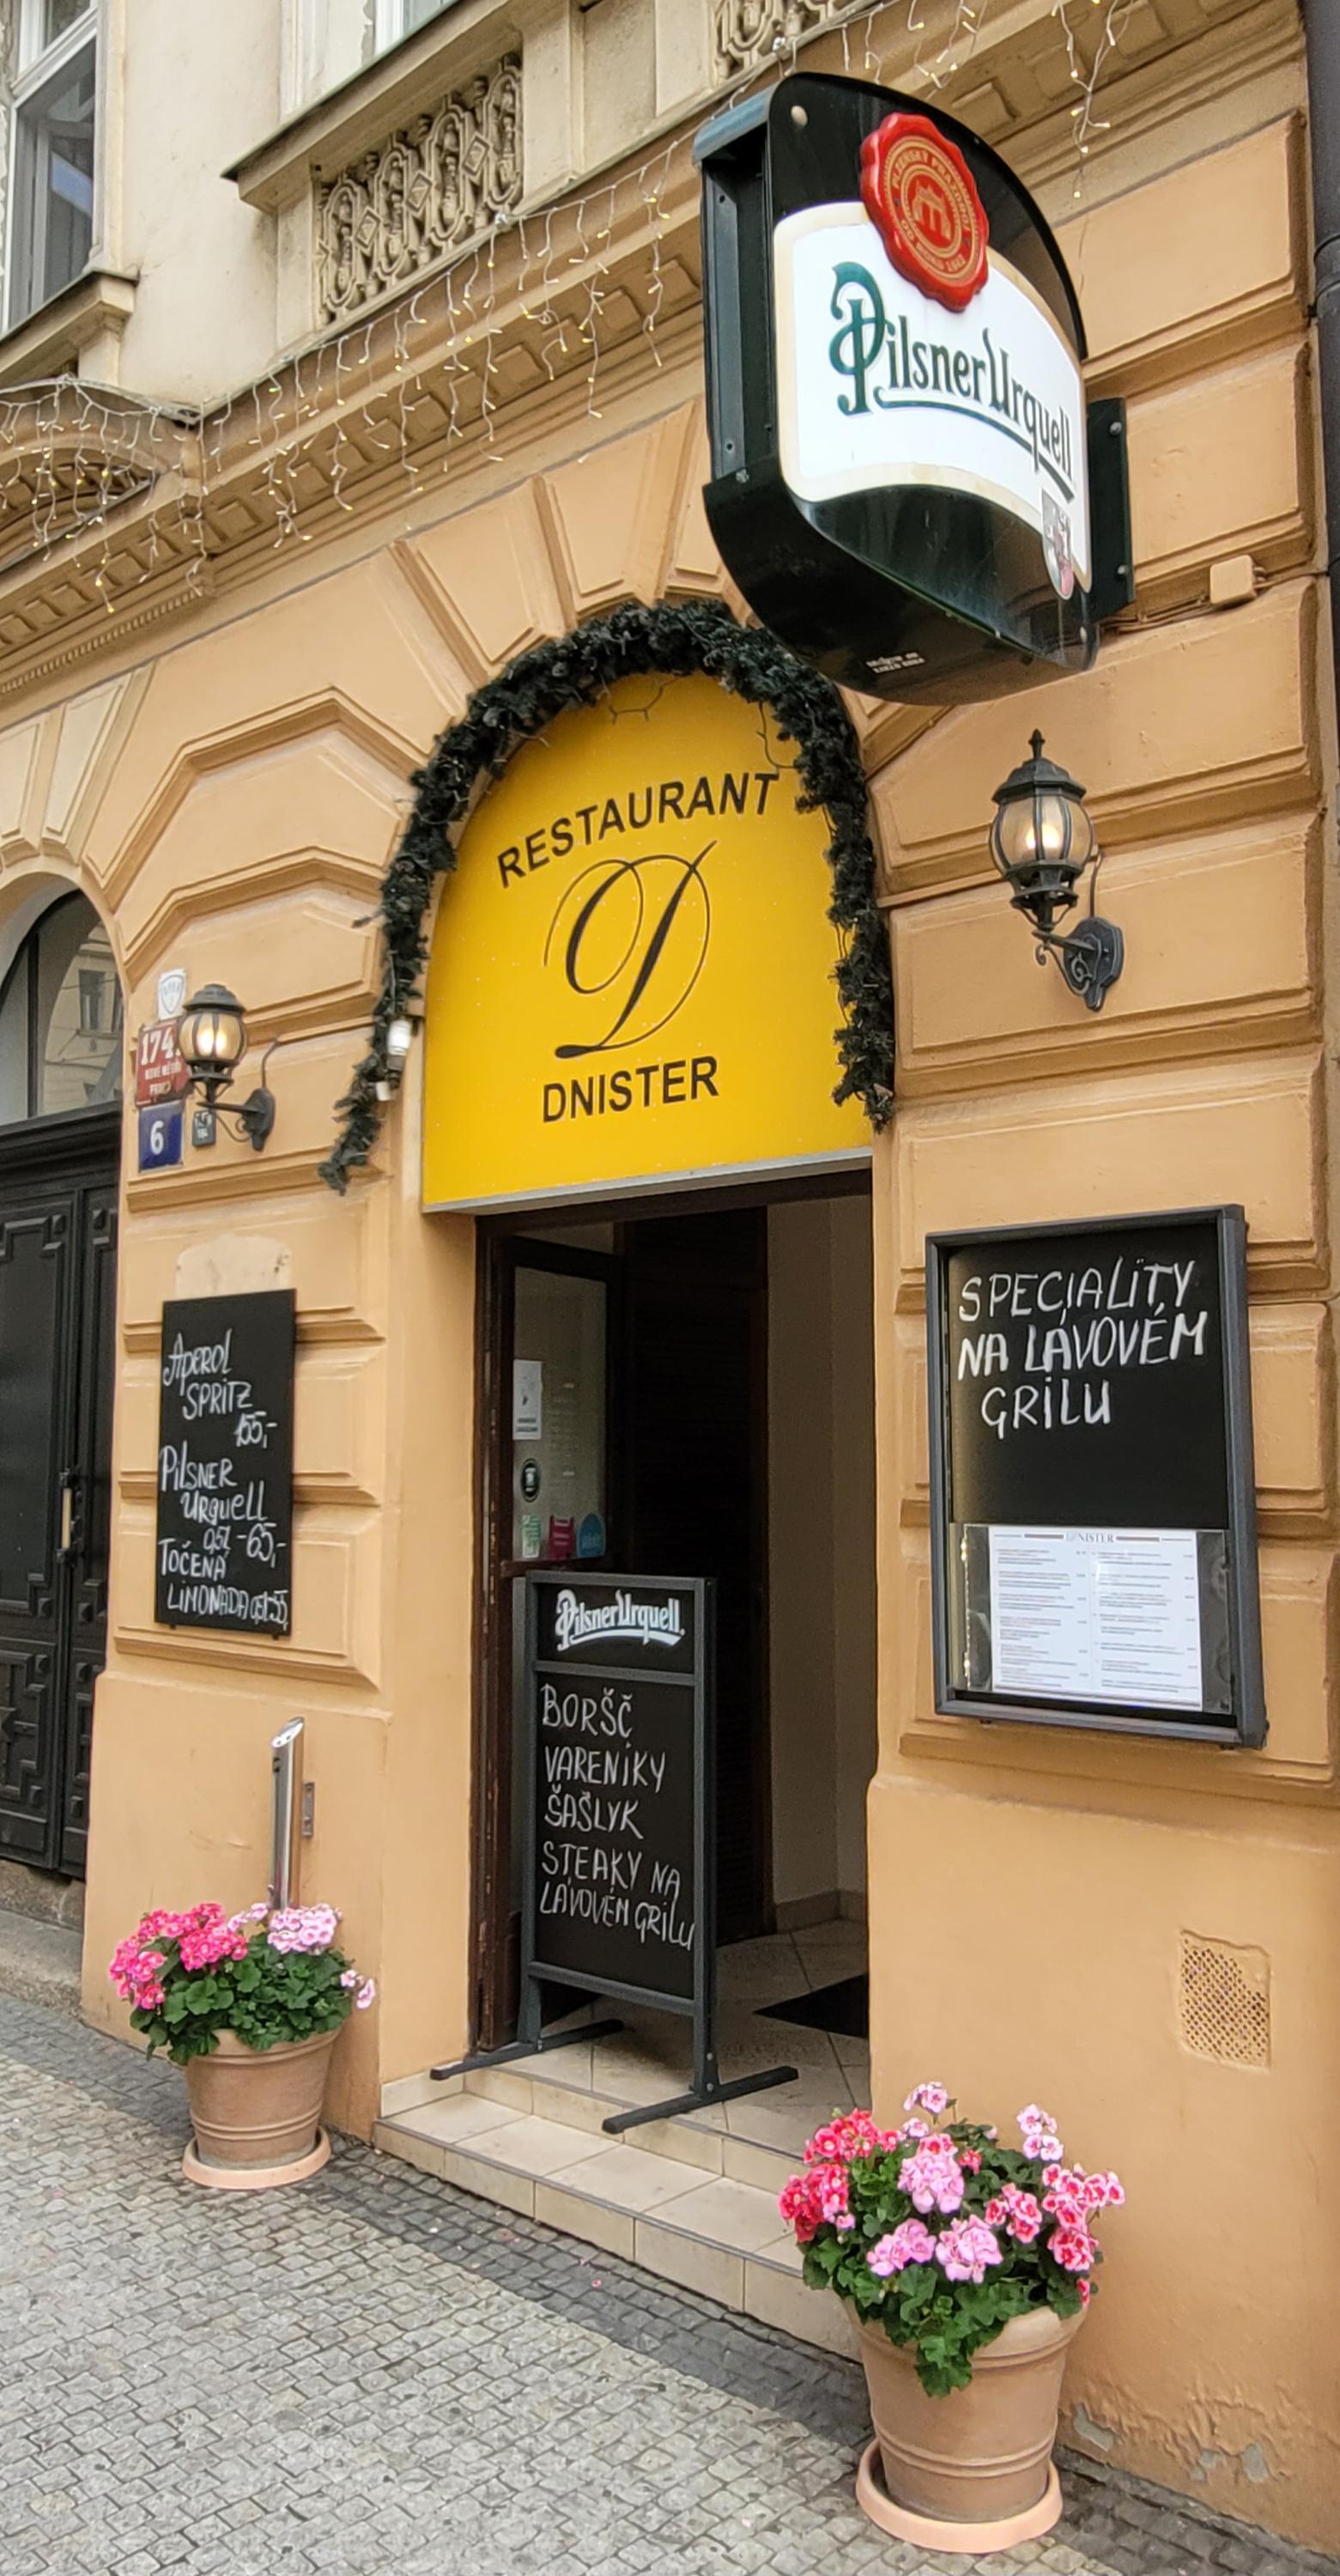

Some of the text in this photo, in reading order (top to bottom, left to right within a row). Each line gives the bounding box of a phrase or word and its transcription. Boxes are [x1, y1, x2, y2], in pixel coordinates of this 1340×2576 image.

[829, 261, 1072, 483] Pilsner Urquell
[496, 773, 779, 889] RESTAURANT
[543, 839, 719, 1060] D
[140, 1027, 181, 1066] 174
[542, 1055, 719, 1123] DNISTER
[150, 1120, 165, 1155] 6
[958, 1302, 1208, 1381] NA LÁVOVÉM
[555, 1589, 620, 1652] Pilsner
[540, 1682, 633, 1739] BORŠČ
[543, 1783, 645, 1840] ŠAŠLYK
[541, 1840, 681, 1897] STEAKY NA
